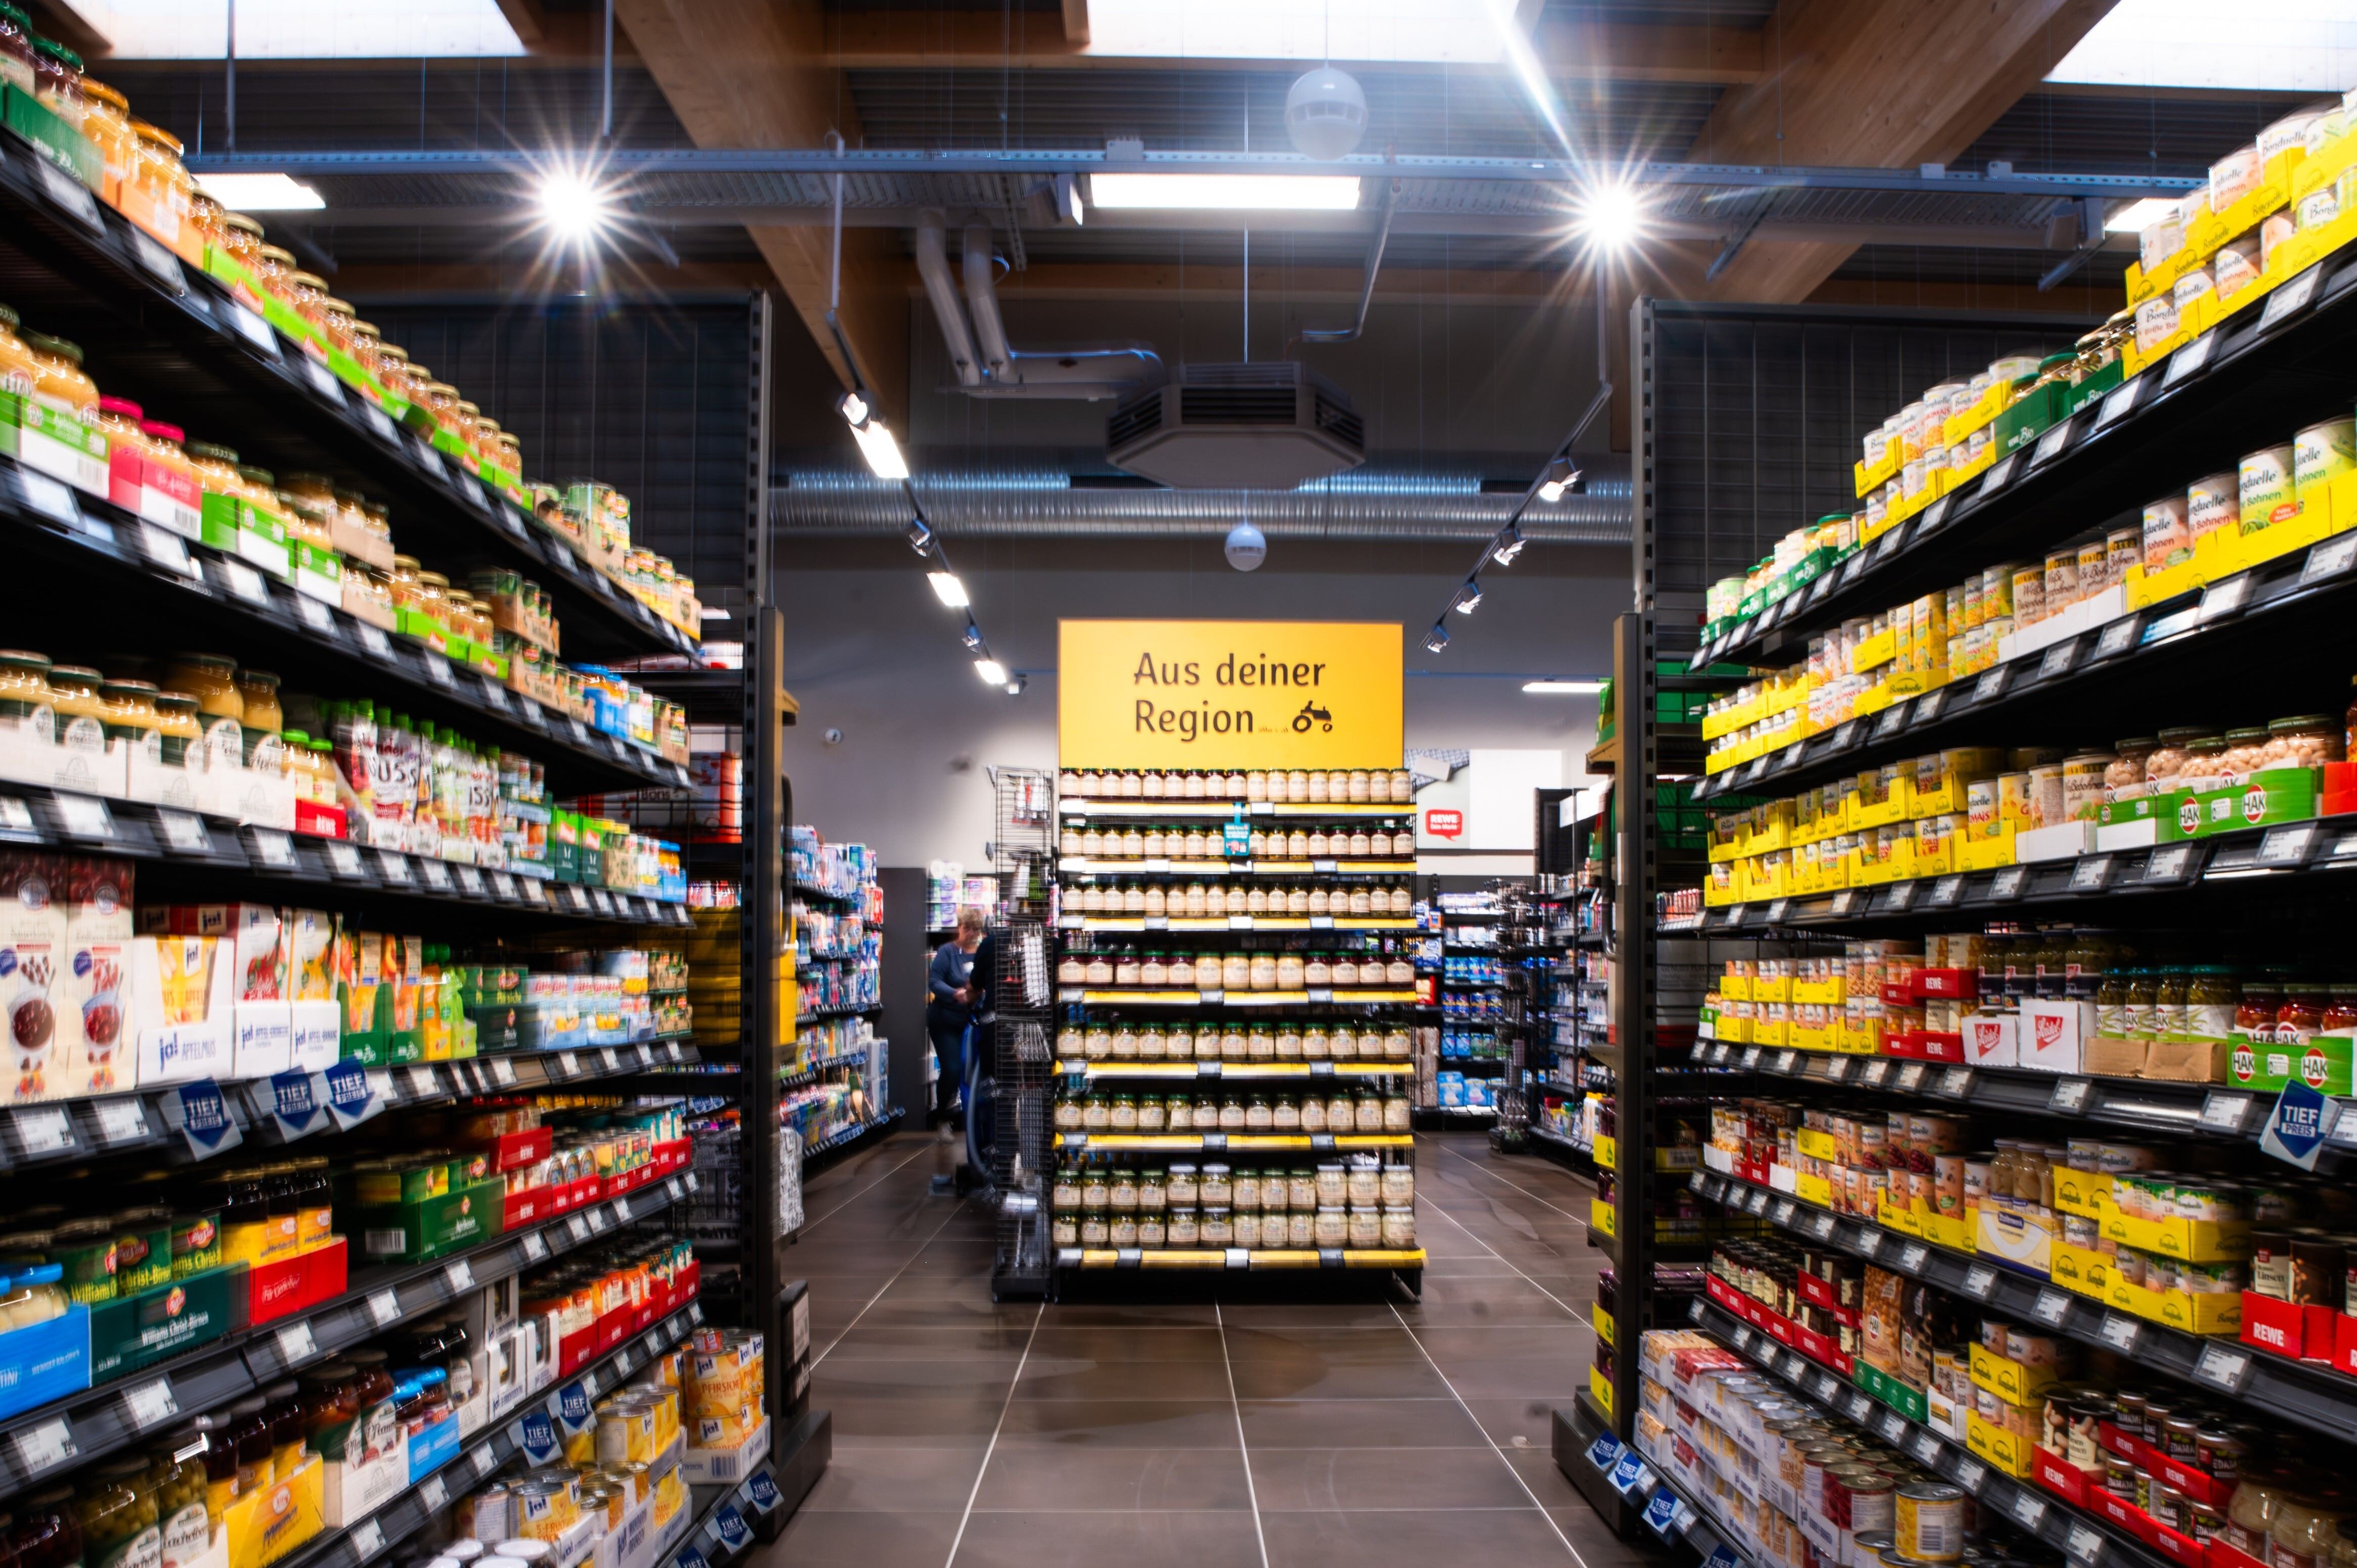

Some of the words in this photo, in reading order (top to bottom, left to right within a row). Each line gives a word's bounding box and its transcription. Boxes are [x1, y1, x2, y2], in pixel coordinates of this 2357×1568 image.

[2262, 132, 2306, 156] Bonduelle
[2219, 183, 2246, 197] Bohnen
[2252, 190, 2284, 218] Bonduelle
[2203, 226, 2230, 251] Bonduelle
[2223, 270, 2248, 284] Bohnen
[2132, 285, 2156, 304] Bonduelle
[2020, 427, 2034, 446] Bio
[2247, 490, 2282, 507] Bohnen
[2196, 515, 2230, 530] Bohnen
[2147, 537, 2174, 553] Bohnen
[1134, 652, 1200, 686] Aus
[1216, 653, 1326, 686] deiner
[1889, 682, 1923, 695] Bonduelle
[1136, 700, 1253, 742] Region
[2242, 792, 2265, 812] HAK
[1430, 814, 1457, 823] REWE
[2101, 811, 2111, 820] HAK
[2179, 808, 2200, 824] HAK
[315, 814, 336, 837] REWE
[186, 945, 199, 970] ja!
[1925, 977, 1942, 990] REWE
[242, 1022, 253, 1050] ja!
[295, 1027, 306, 1054] ja!
[159, 1031, 179, 1074] ja!
[181, 1038, 216, 1062] APFELMUS
[1927, 1042, 1943, 1055] REWE
[2233, 1054, 2255, 1071] HAK
[2302, 1058, 2328, 1077] HAK
[277, 1082, 310, 1102] TIEF
[331, 1073, 364, 1093] TIEF
[186, 1095, 220, 1116] TIEF
[2284, 1105, 2319, 1125] TIEF
[2286, 1125, 2312, 1137] PREIS
[2066, 1225, 2098, 1237] Bonduelle
[2257, 1270, 2285, 1284] Linsen
[70, 1282, 110, 1304] Williams
[142, 1326, 169, 1346] Williams
[169, 1311, 208, 1338] Christ-Birnen
[1869, 1317, 1880, 1332] HAK
[2253, 1321, 2285, 1348] REWE
[696, 1359, 714, 1374] ja!
[564, 1398, 585, 1410] TIEF
[527, 1426, 549, 1439] TIEF
[703, 1422, 719, 1437] ja!
[1598, 1440, 1615, 1453] TIEF
[2115, 1437, 2134, 1455] REWE
[1620, 1461, 1638, 1474] TIEF
[2044, 1466, 2065, 1489] REWE
[2165, 1467, 2186, 1487] REWE
[753, 1482, 771, 1492] TIEF
[529, 1498, 547, 1517] ja!
[1655, 1498, 1673, 1511] TIEF
[2108, 1502, 2126, 1521] REWE
[721, 1517, 739, 1530] TIEF
[2159, 1533, 2179, 1553] REWE
[1712, 1555, 1732, 1568] TIEF
